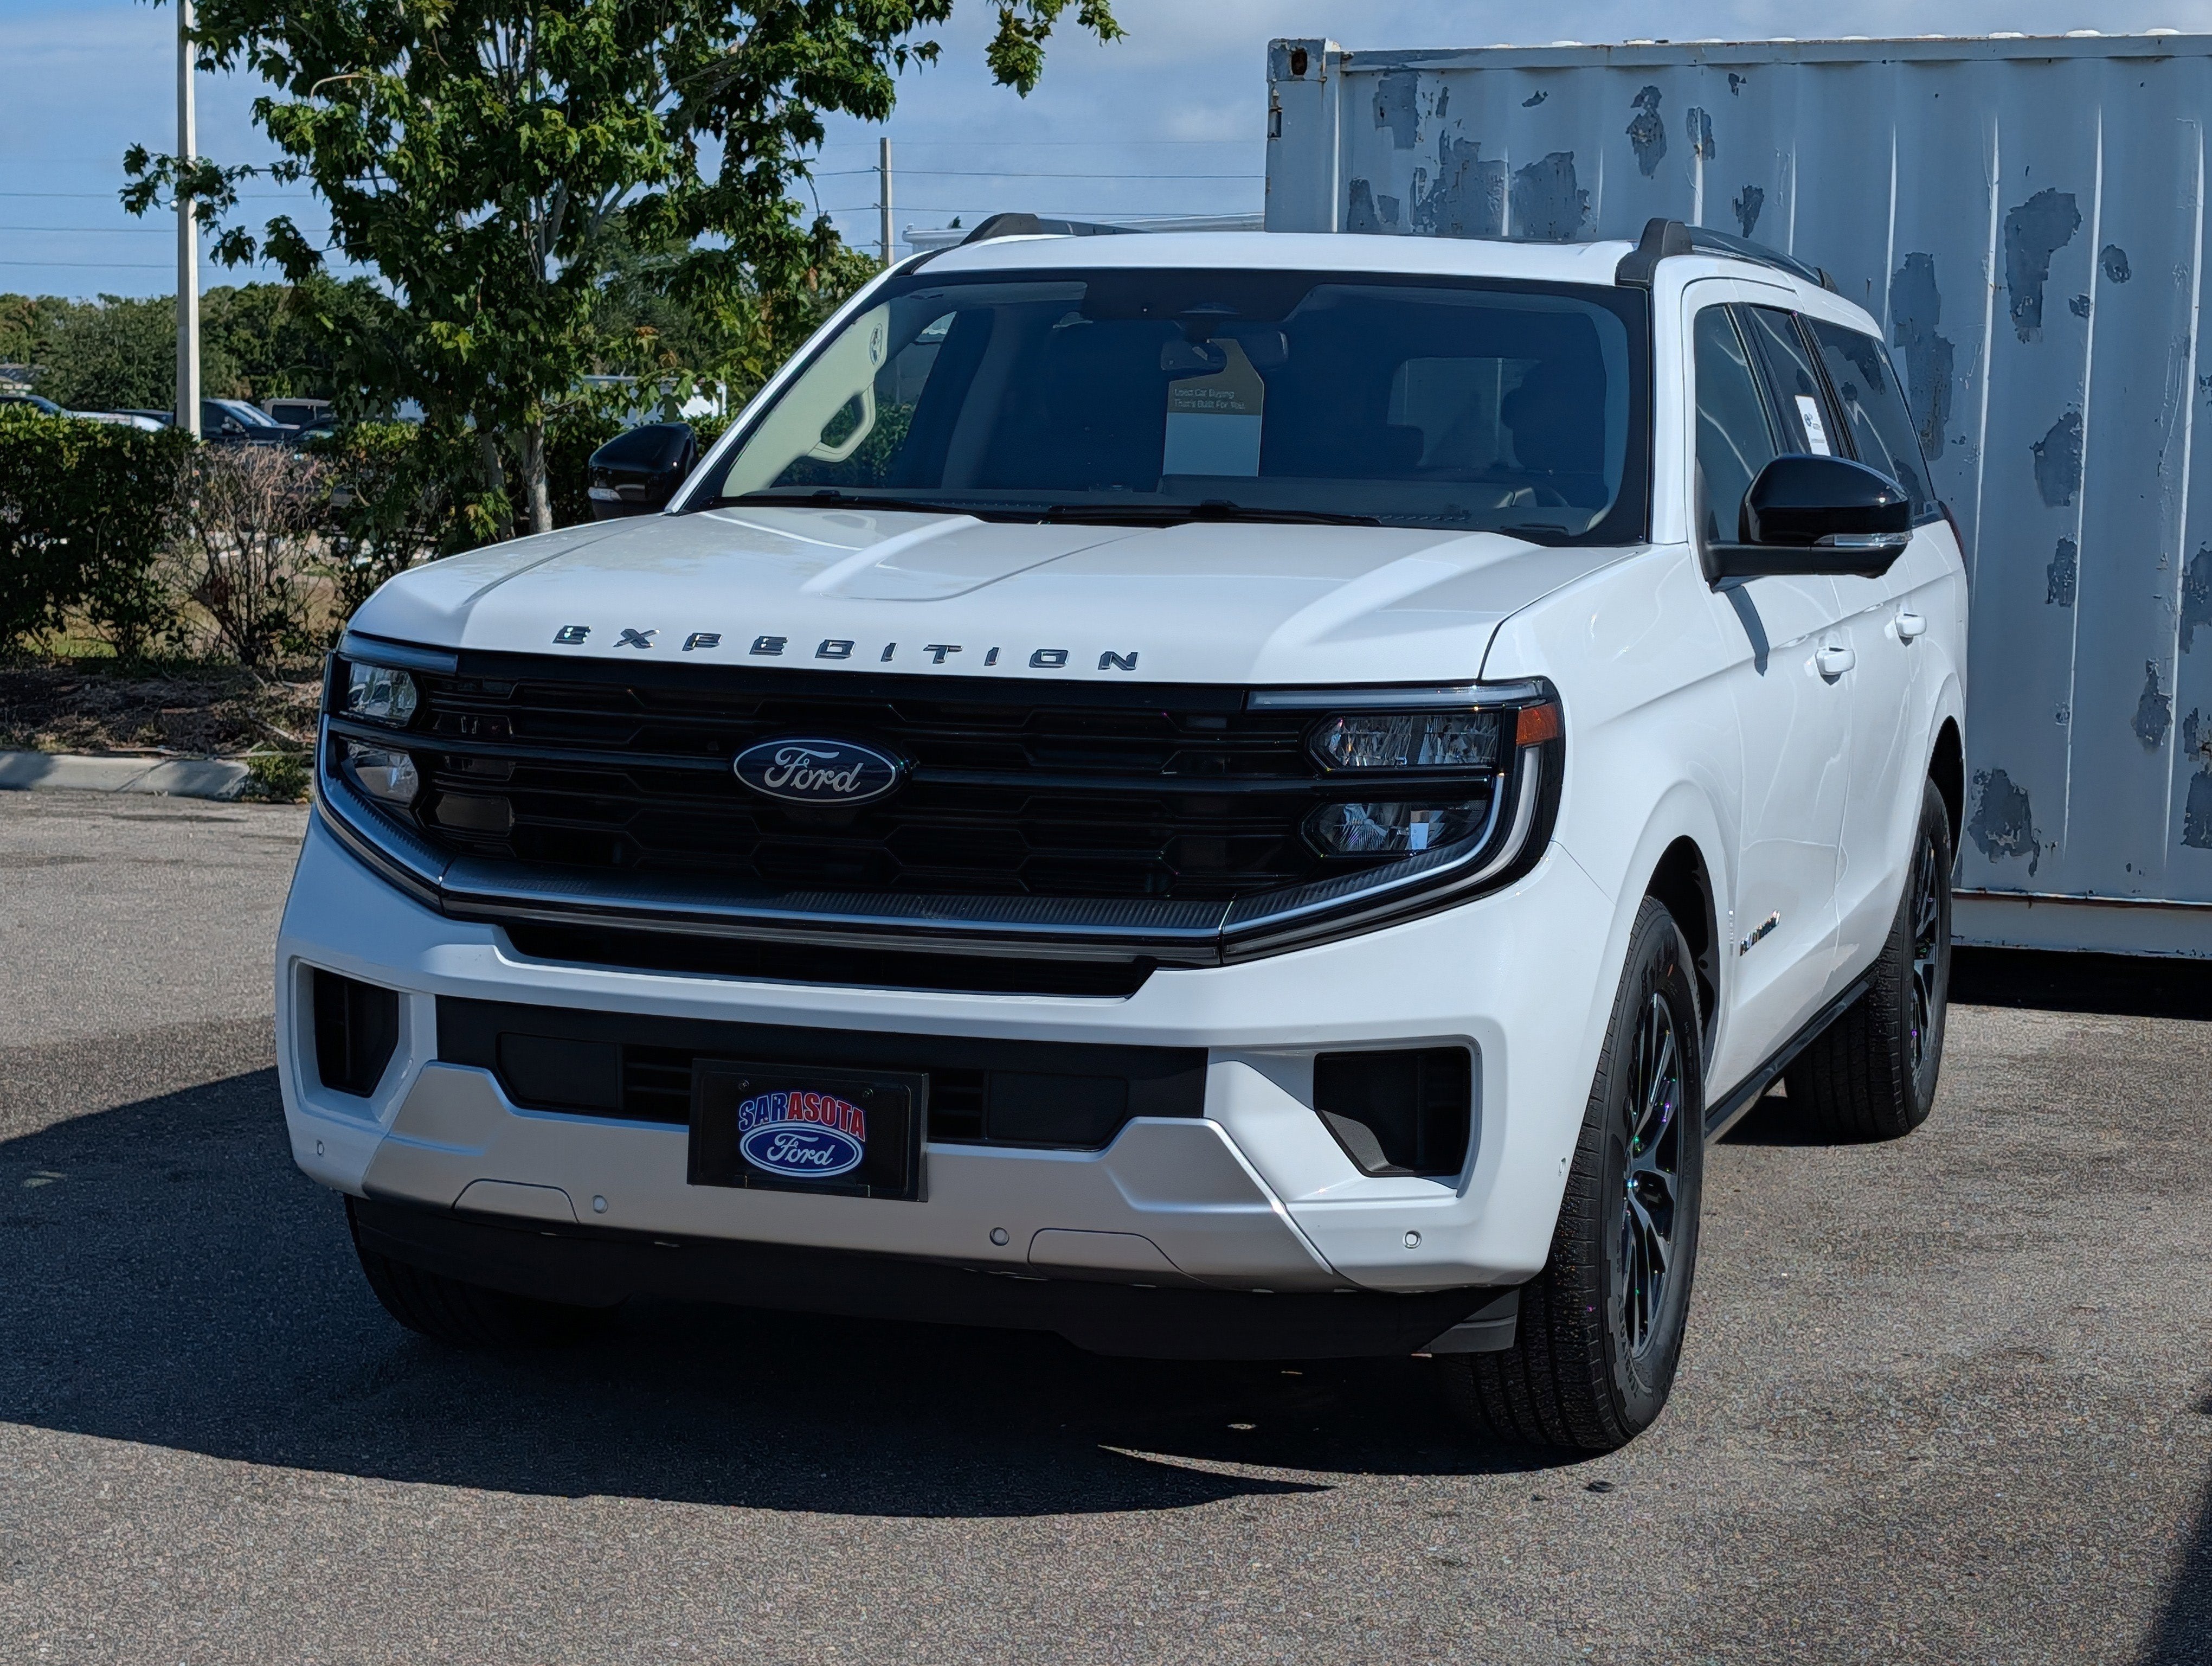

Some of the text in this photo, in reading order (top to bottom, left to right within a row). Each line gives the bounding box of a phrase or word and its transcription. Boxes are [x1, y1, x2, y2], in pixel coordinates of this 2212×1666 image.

[552, 625, 1139, 670] EXPEDITION
[764, 747, 864, 792] Ford
[738, 1092, 866, 1142] SARASOTA
[767, 1133, 835, 1165] Ford
